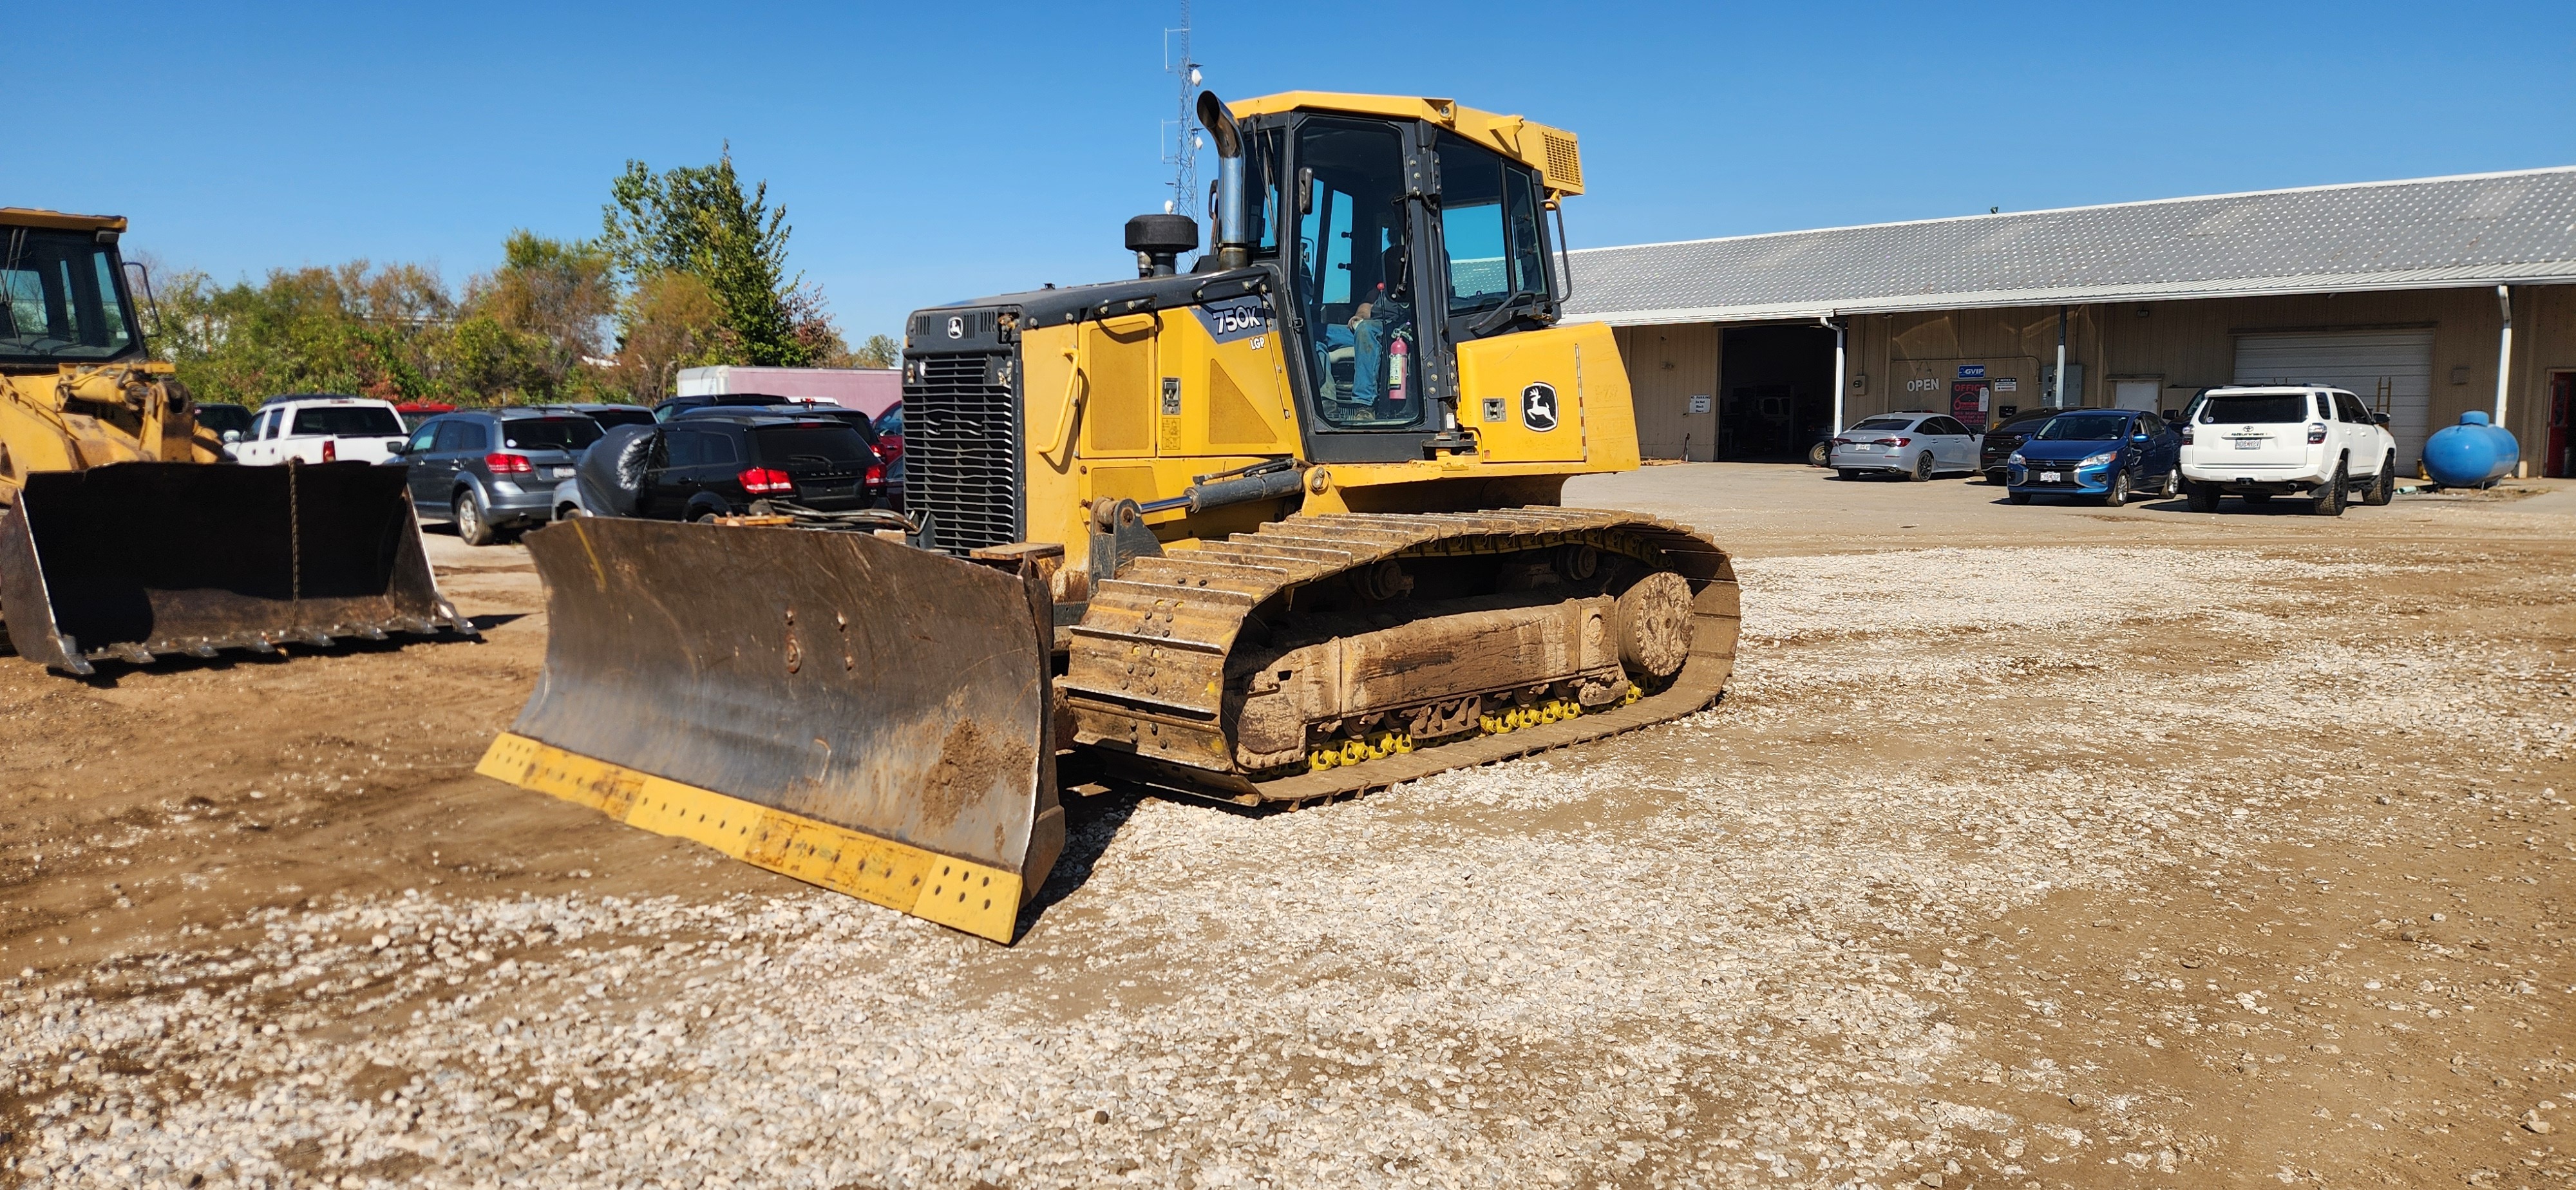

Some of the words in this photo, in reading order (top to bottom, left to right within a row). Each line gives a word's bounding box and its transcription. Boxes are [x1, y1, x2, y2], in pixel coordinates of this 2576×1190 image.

[1213, 306, 1261, 334] 750K
[1250, 337, 1265, 350] LGP
[1907, 378, 1940, 392] OPEN
